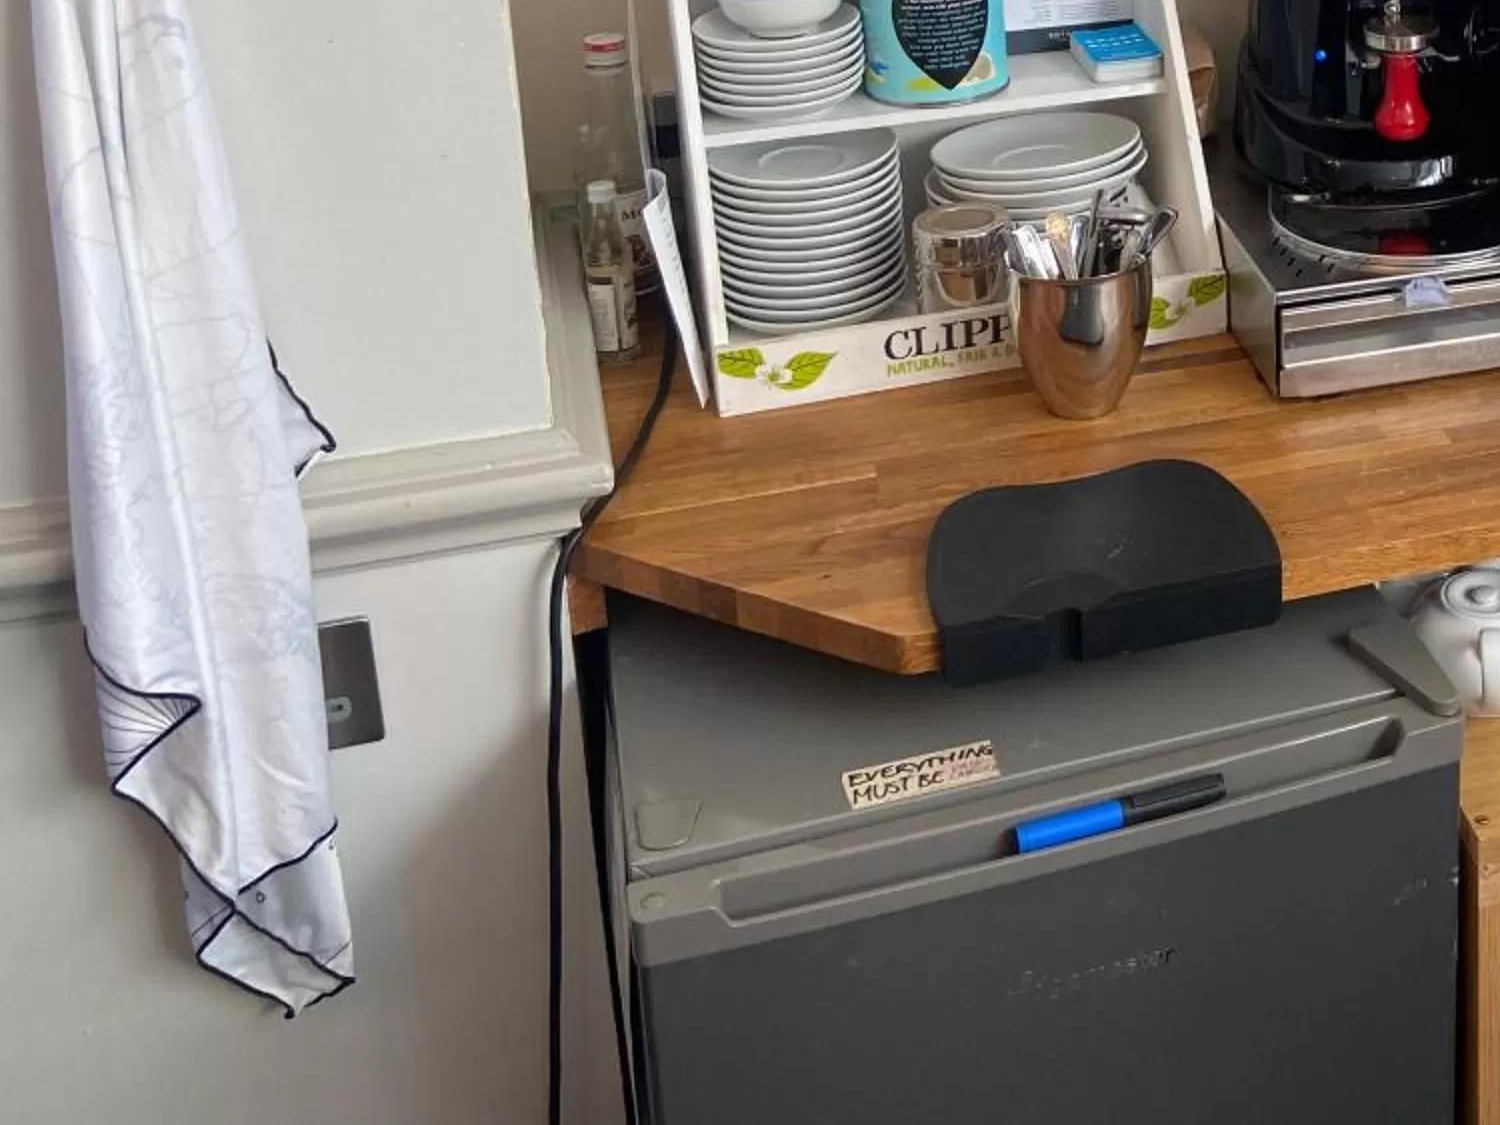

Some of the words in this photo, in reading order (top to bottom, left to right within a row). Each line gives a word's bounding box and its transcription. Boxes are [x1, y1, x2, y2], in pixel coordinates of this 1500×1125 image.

[884, 314, 1012, 360] CLIPP
[848, 744, 992, 787] EVERYTHING
[853, 776, 910, 804] MUST
[918, 771, 945, 788] BE
